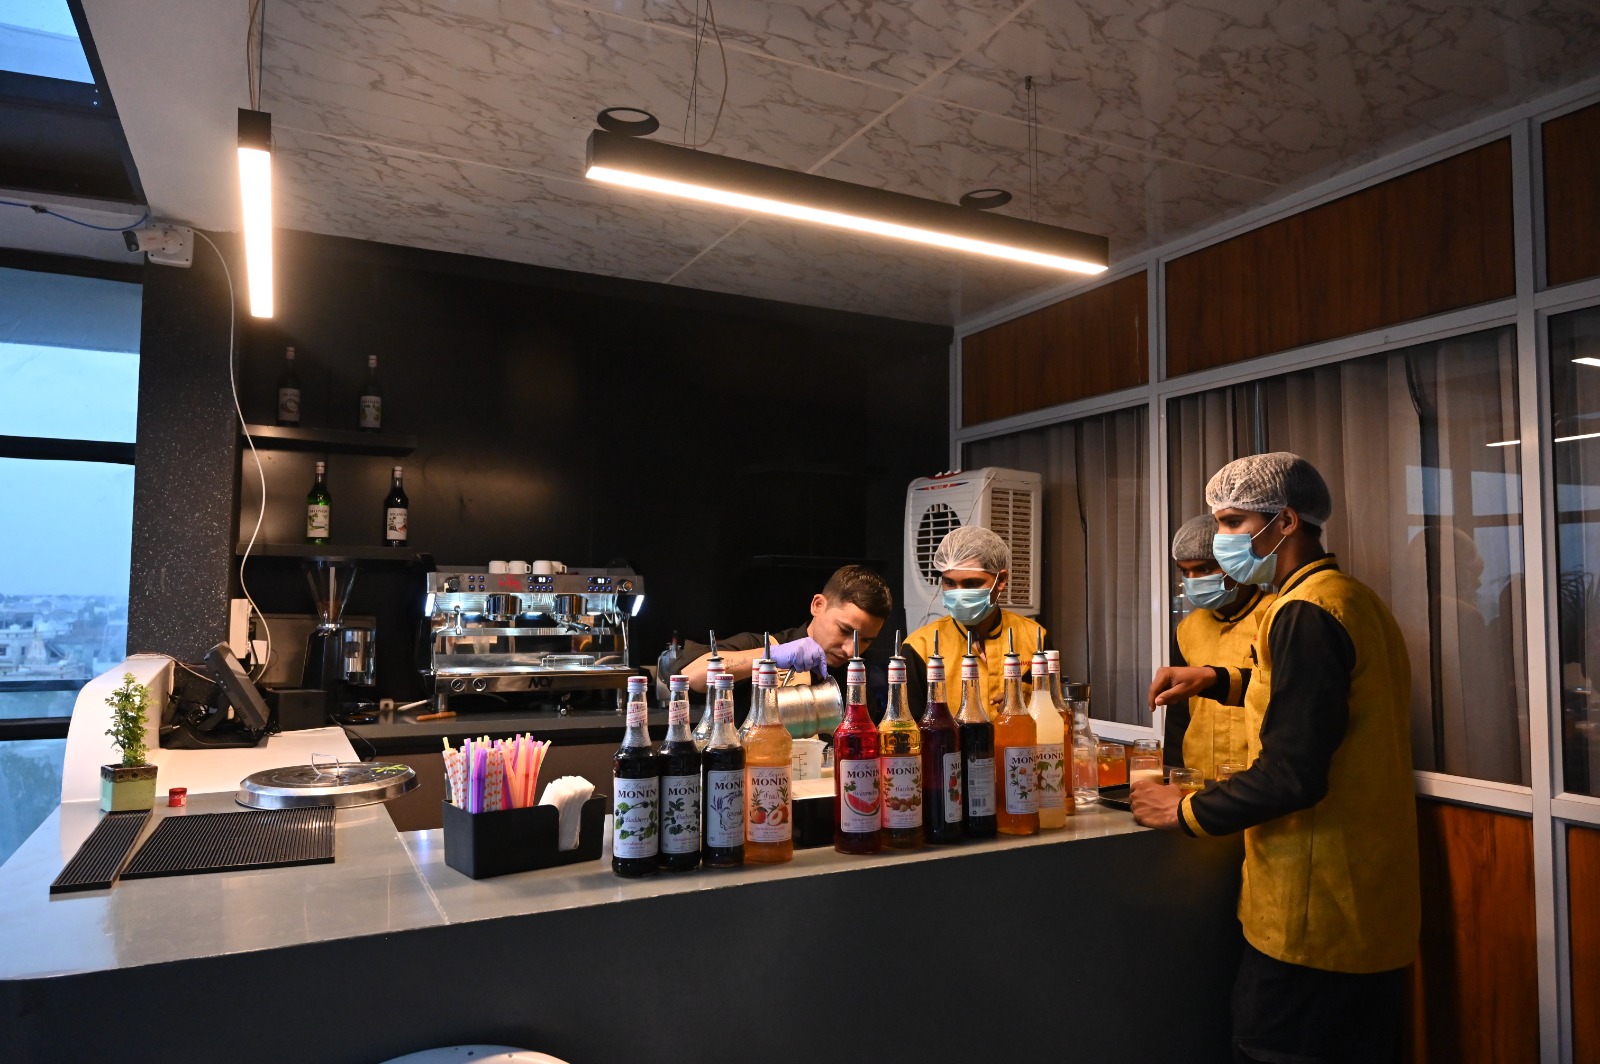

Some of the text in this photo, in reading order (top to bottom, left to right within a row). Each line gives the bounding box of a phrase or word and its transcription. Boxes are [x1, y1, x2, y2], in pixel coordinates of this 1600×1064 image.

[847, 768, 880, 778] MONIN
[886, 766, 920, 776] MONIN
[751, 776, 789, 786] MONIN
[617, 787, 658, 799] MONIN
